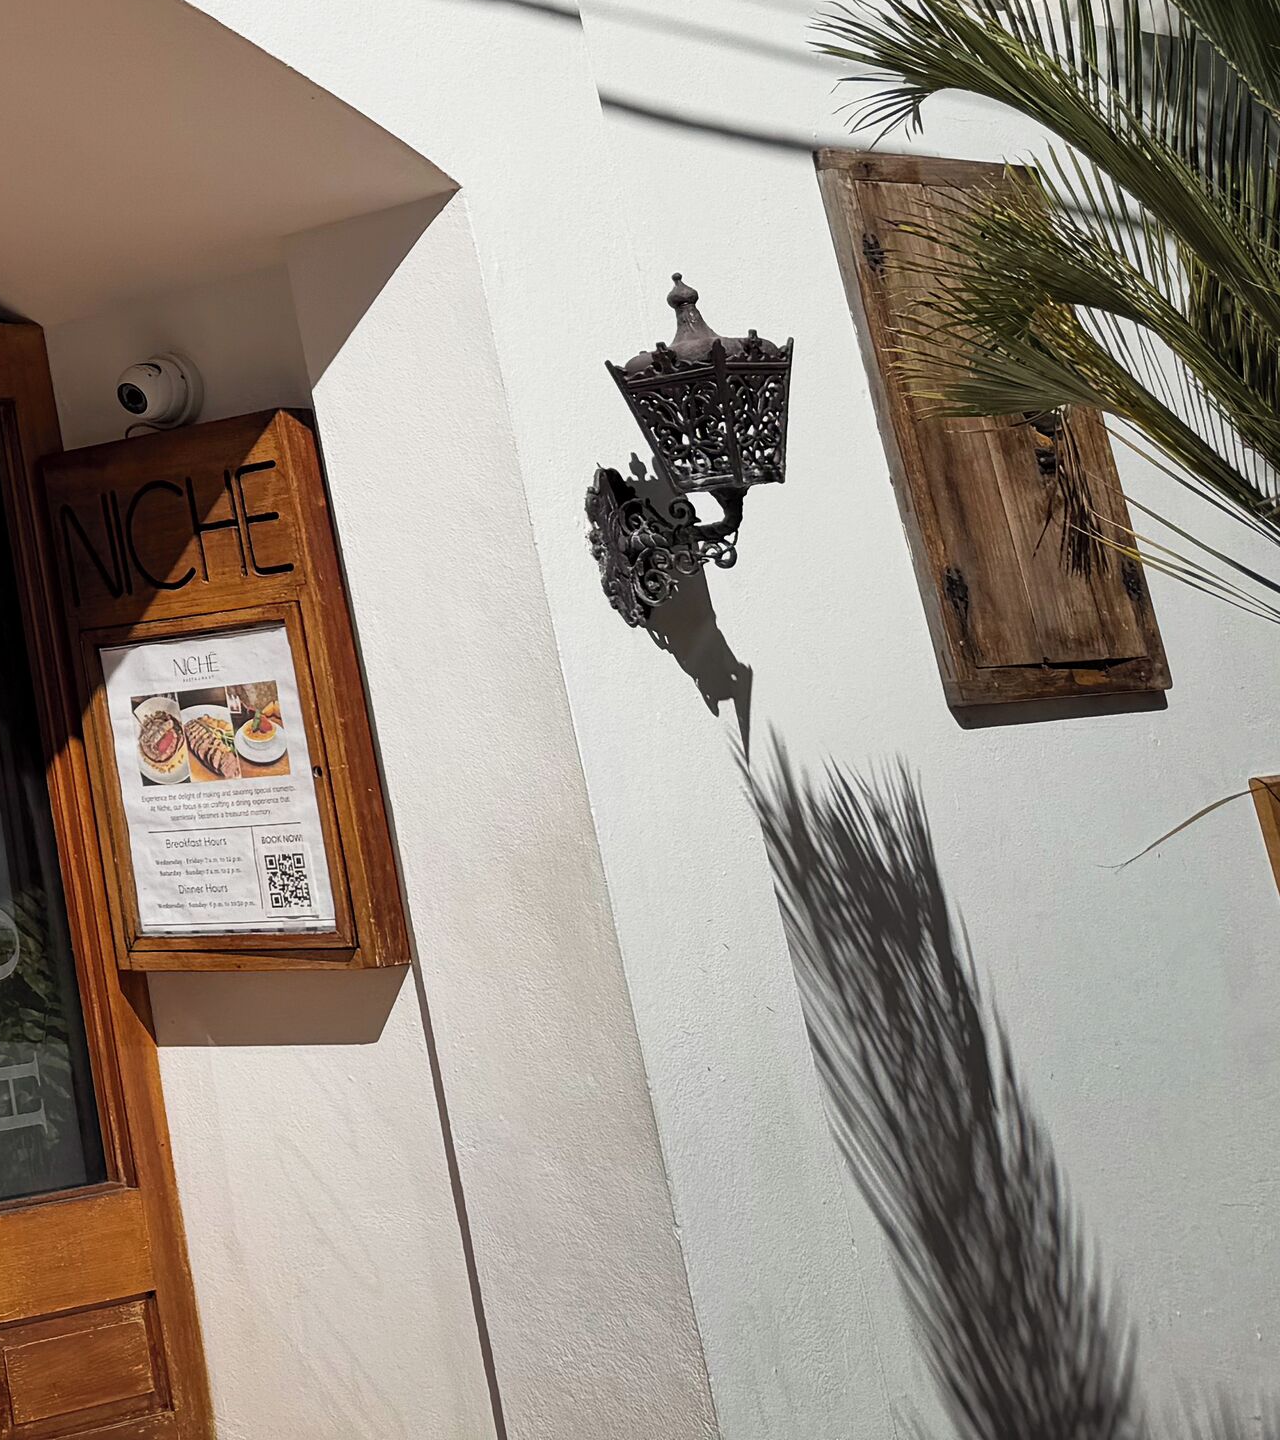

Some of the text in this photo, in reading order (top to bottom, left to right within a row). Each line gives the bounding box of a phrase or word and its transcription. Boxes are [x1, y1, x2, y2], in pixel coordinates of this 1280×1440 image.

[59, 458, 295, 606] NICHE
[165, 836, 227, 849] Breakfast Hours
[261, 835, 282, 844] BOOK
[178, 884, 228, 894] Dinner Hours
